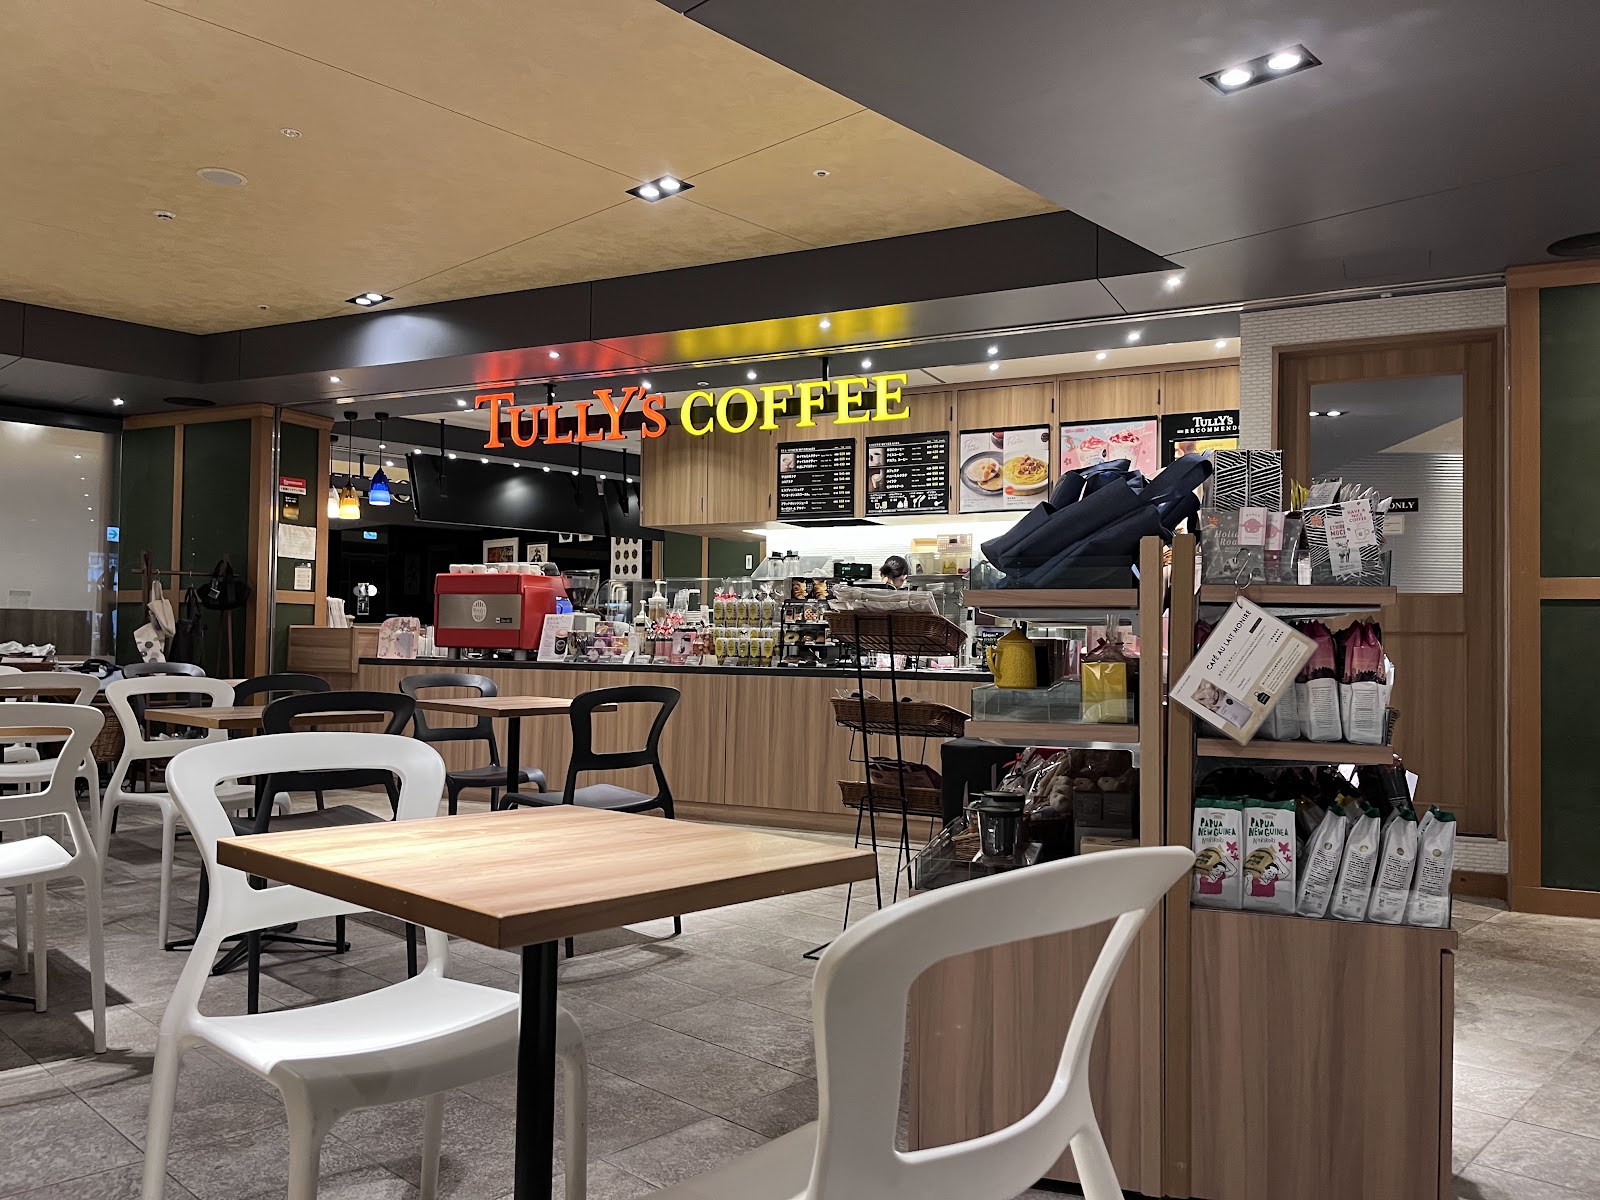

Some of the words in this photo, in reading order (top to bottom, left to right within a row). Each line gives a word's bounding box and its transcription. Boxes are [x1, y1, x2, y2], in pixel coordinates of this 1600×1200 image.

[475, 386, 667, 449] TULLY'S
[680, 373, 910, 436] COFFEE
[1192, 415, 1234, 428] TULLY'S
[1219, 538, 1238, 546] Roa
[1217, 645, 1226, 656] AU
[1223, 633, 1235, 646] LAIT
[1200, 817, 1223, 828] PAPUA
[1250, 817, 1275, 828] PAPUA
[1198, 827, 1213, 836] NEW
[1213, 827, 1237, 837] GUINEA
[1248, 827, 1264, 836] NEW
[1264, 827, 1289, 837] GUINEA
